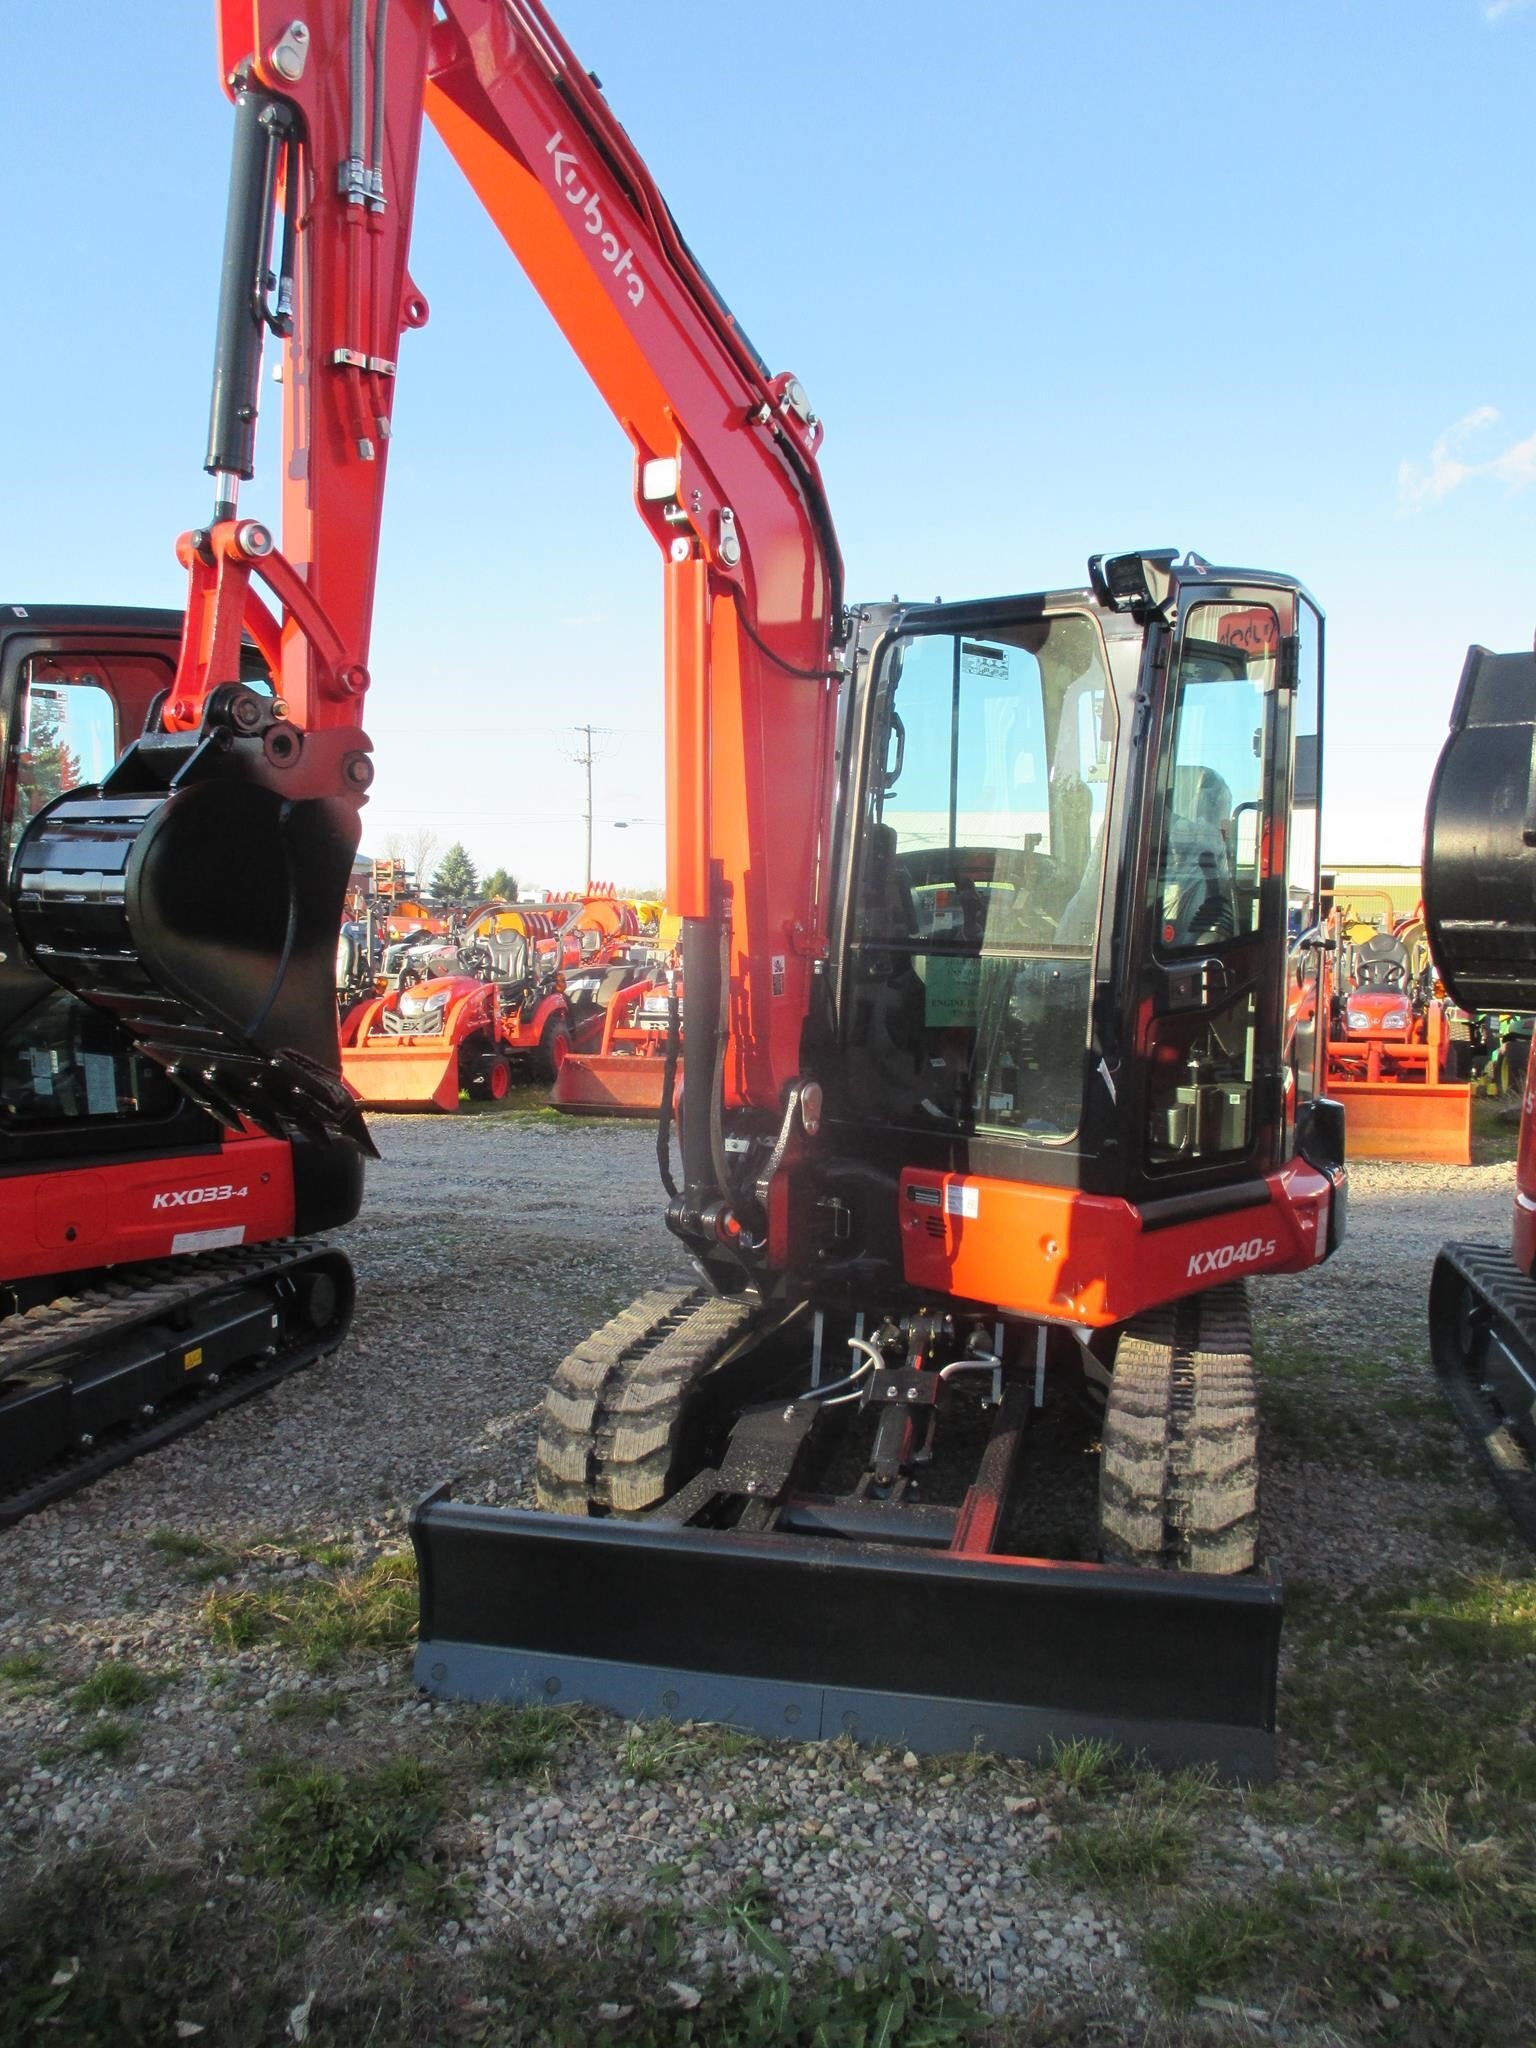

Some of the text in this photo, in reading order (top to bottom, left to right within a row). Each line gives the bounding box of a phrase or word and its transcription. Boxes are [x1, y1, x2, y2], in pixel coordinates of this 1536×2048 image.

[545, 131, 644, 307] Kubota
[152, 1185, 248, 1209] KX033-4
[1186, 1238, 1276, 1277] KX040-5
